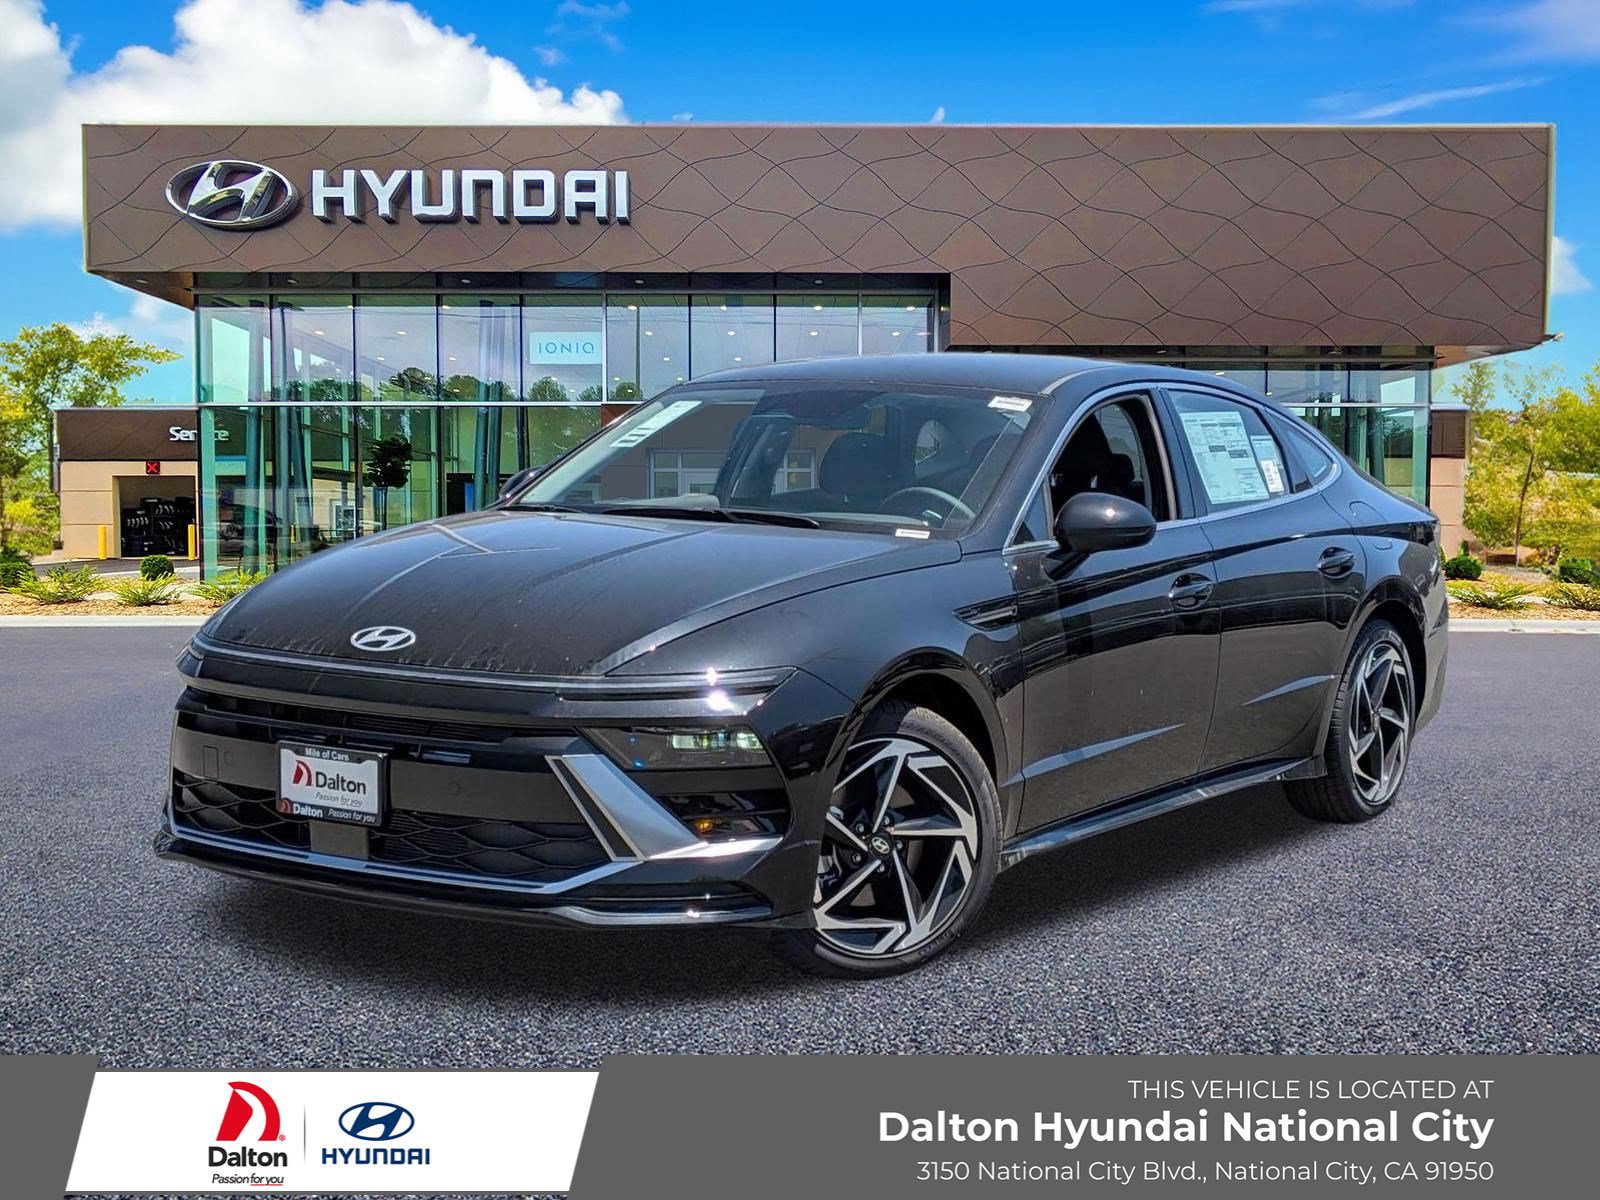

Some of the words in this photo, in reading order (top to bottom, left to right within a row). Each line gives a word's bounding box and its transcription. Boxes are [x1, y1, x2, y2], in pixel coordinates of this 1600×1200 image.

[311, 169, 630, 222] HYUNDAI
[538, 342, 594, 354] IONIQ
[169, 426, 229, 441] Sere
[305, 747, 320, 758] Mile
[322, 750, 330, 758] of
[330, 751, 350, 761] Cars
[315, 771, 367, 795] Dalton
[315, 791, 339, 802] Passion
[340, 795, 350, 806] for
[293, 803, 323, 818] Dalton
[328, 809, 351, 819] Passion
[352, 812, 363, 820] for
[363, 815, 376, 824] you
